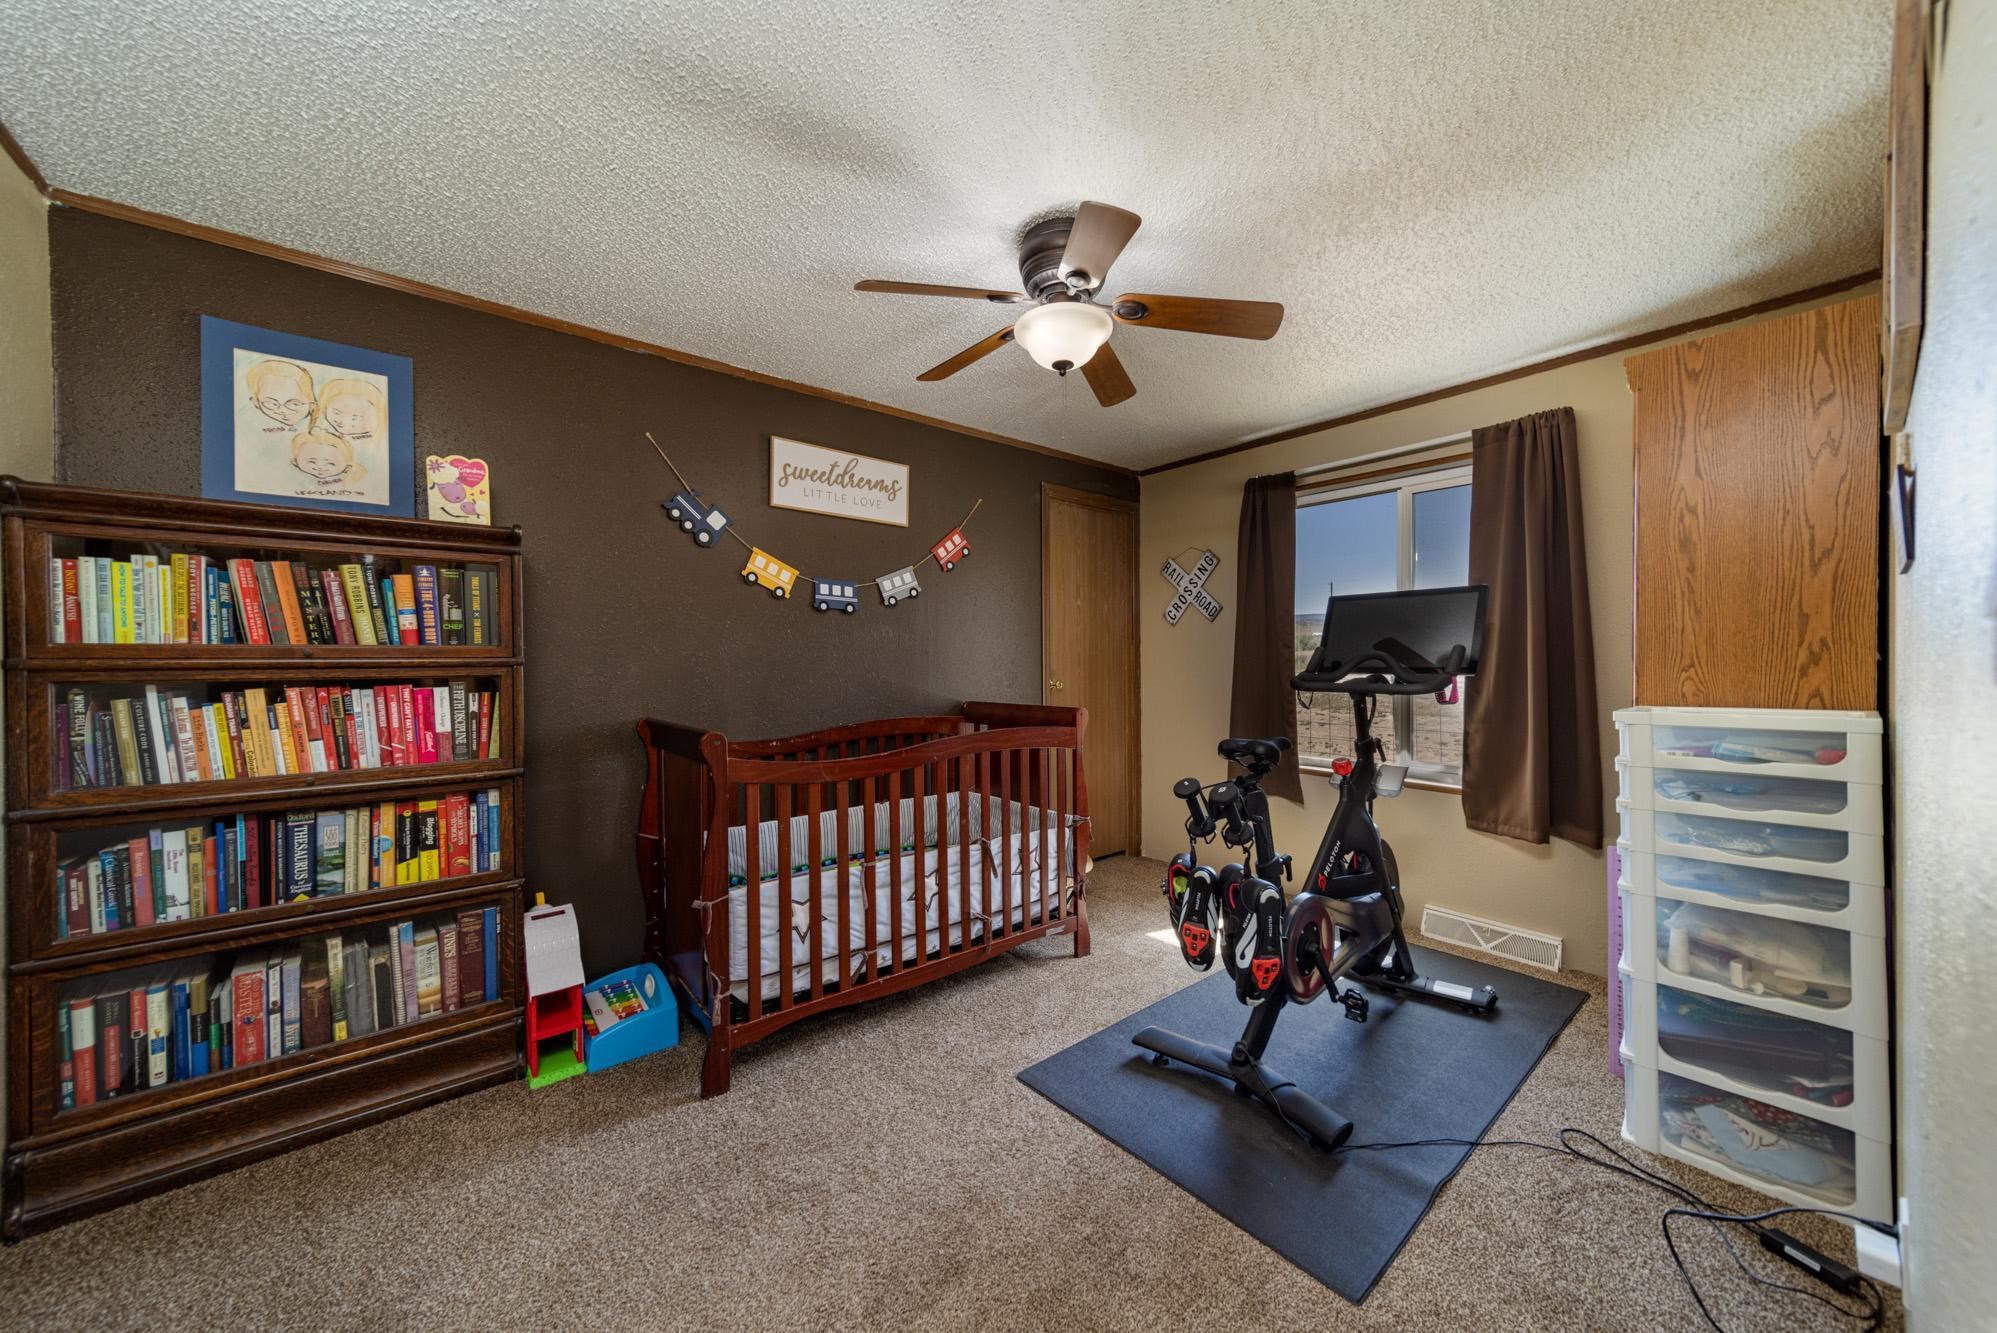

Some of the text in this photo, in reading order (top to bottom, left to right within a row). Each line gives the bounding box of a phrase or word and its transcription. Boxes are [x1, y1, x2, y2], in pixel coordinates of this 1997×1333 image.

[803, 488, 882, 509] LITTLE LOVE
[366, 570, 374, 584] TONY
[1162, 562, 1218, 617] RAIL ROAD
[1167, 556, 1214, 620] CROSSING
[65, 570, 78, 620] INSTANT ANALYSIS
[346, 567, 358, 584] TONY
[352, 585, 365, 614] ROBBINS
[369, 585, 378, 606] ROBBINS
[421, 590, 433, 601] THE
[425, 628, 437, 644] BODY
[225, 694, 234, 718] COLORADO
[344, 695, 354, 714] SHIFT
[403, 688, 411, 702] THEY
[73, 694, 86, 734] WINE FOLLY
[135, 705, 146, 731] CULTURE
[404, 703, 412, 719] CAN'T
[453, 690, 467, 744] FIFTH DISCIPLINE
[228, 719, 237, 737] TRAILS
[138, 733, 149, 749] CODE
[425, 817, 436, 845] Blogging
[294, 825, 309, 880] THESAURUS
[1323, 840, 1341, 877] PELOTON
[104, 858, 116, 907] Classical Greek
[239, 975, 251, 1015] MASTER
[286, 1025, 298, 1047] DYER
